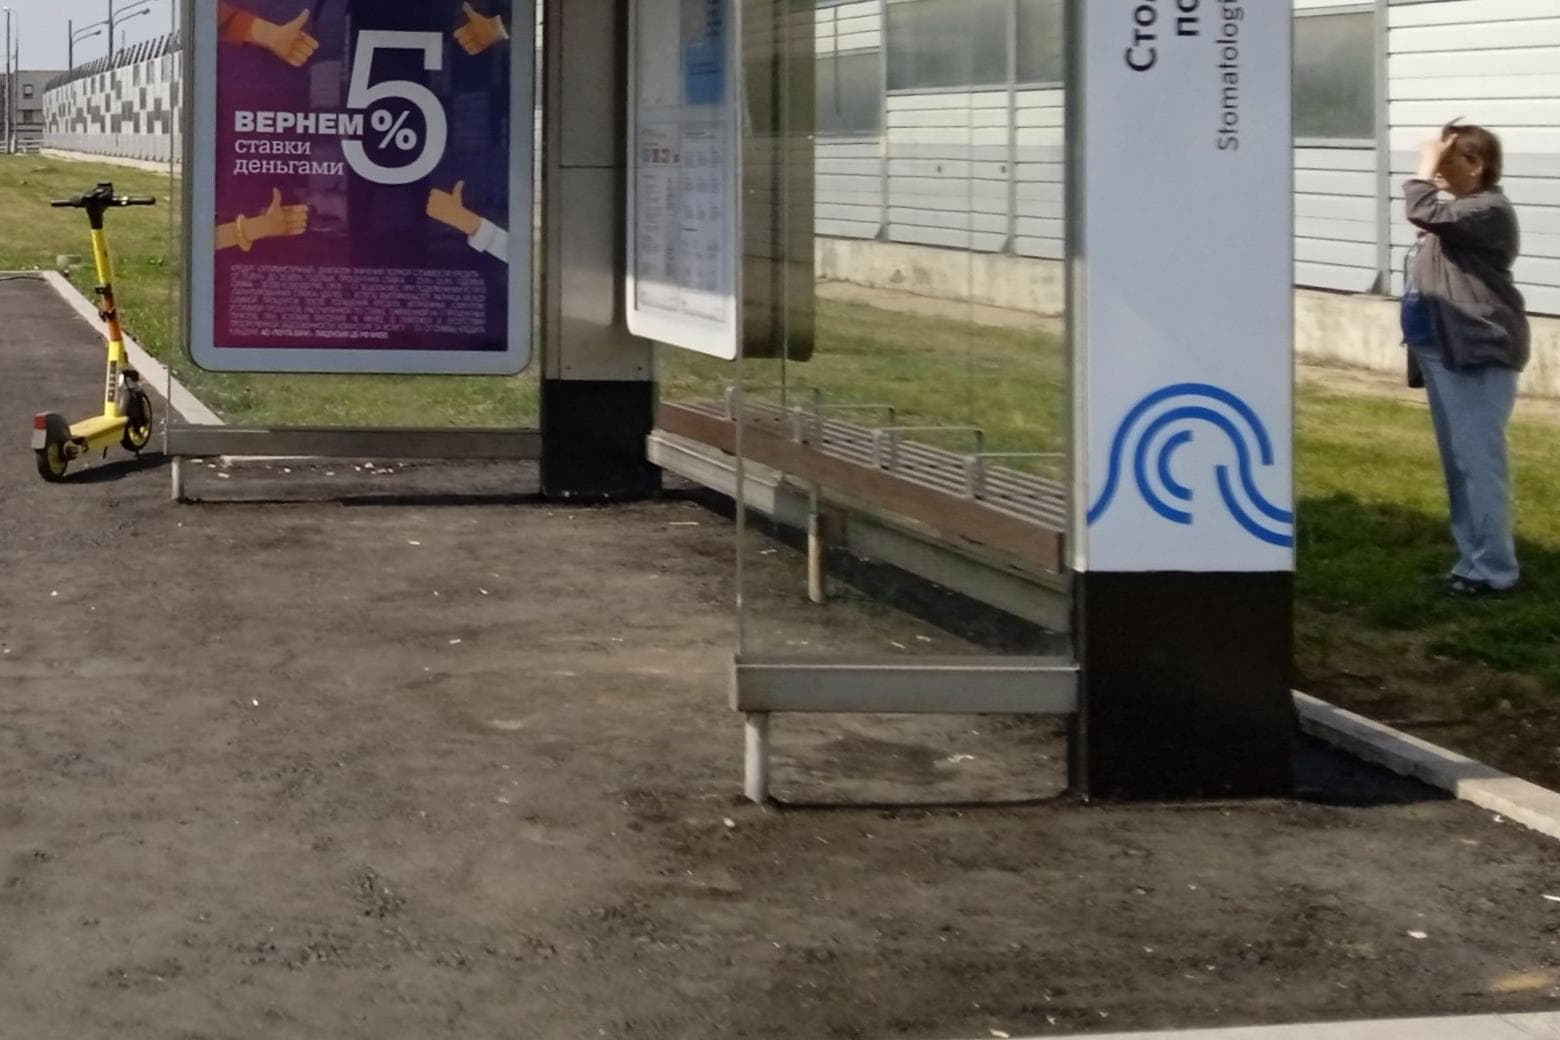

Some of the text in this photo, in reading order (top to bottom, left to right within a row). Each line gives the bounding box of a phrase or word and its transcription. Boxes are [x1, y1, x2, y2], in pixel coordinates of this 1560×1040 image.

[234, 110, 364, 136] ВЕРНЕМ
[234, 139, 312, 155] ставки
[233, 159, 345, 176] деньгами
